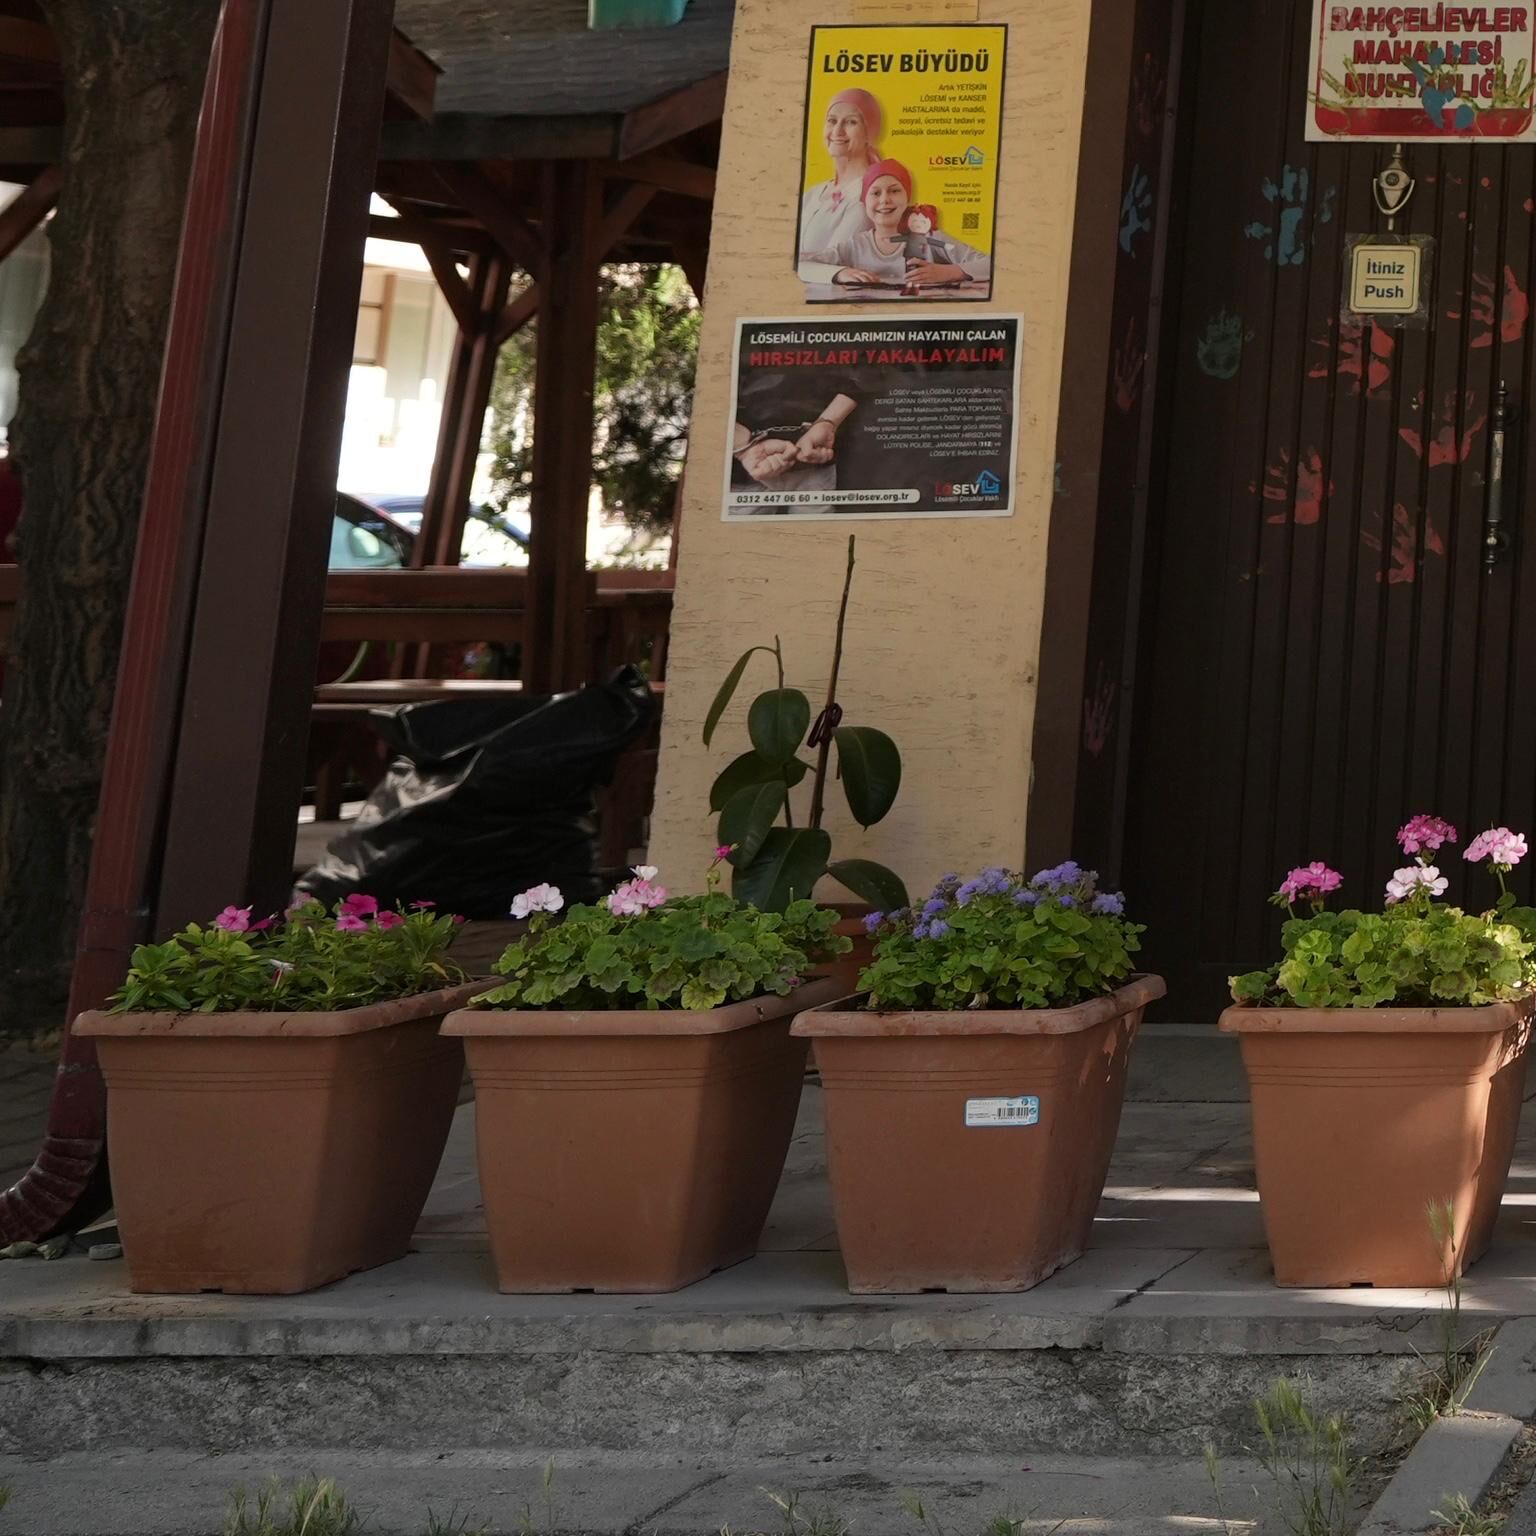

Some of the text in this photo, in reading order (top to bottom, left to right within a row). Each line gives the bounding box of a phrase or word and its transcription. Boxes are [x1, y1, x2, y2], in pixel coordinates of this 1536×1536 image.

[1330, 1, 1528, 38] BAHÇELİEVLER
[823, 48, 990, 73] LÖSEV BÜYÜDÜ
[928, 155, 967, 166] LÖSEV
[1366, 257, 1405, 275] İtiniz
[1364, 284, 1405, 300] Push
[750, 330, 1007, 345] LÖSEMİLİ ÇOCUKLARIMIZIN HAYATINI ÇALAN
[751, 347, 1006, 366] HIRSIZLARI YAKALAYALIM
[736, 495, 760, 505] 0312
[763, 495, 782, 504] 447
[784, 494, 796, 503] 06
